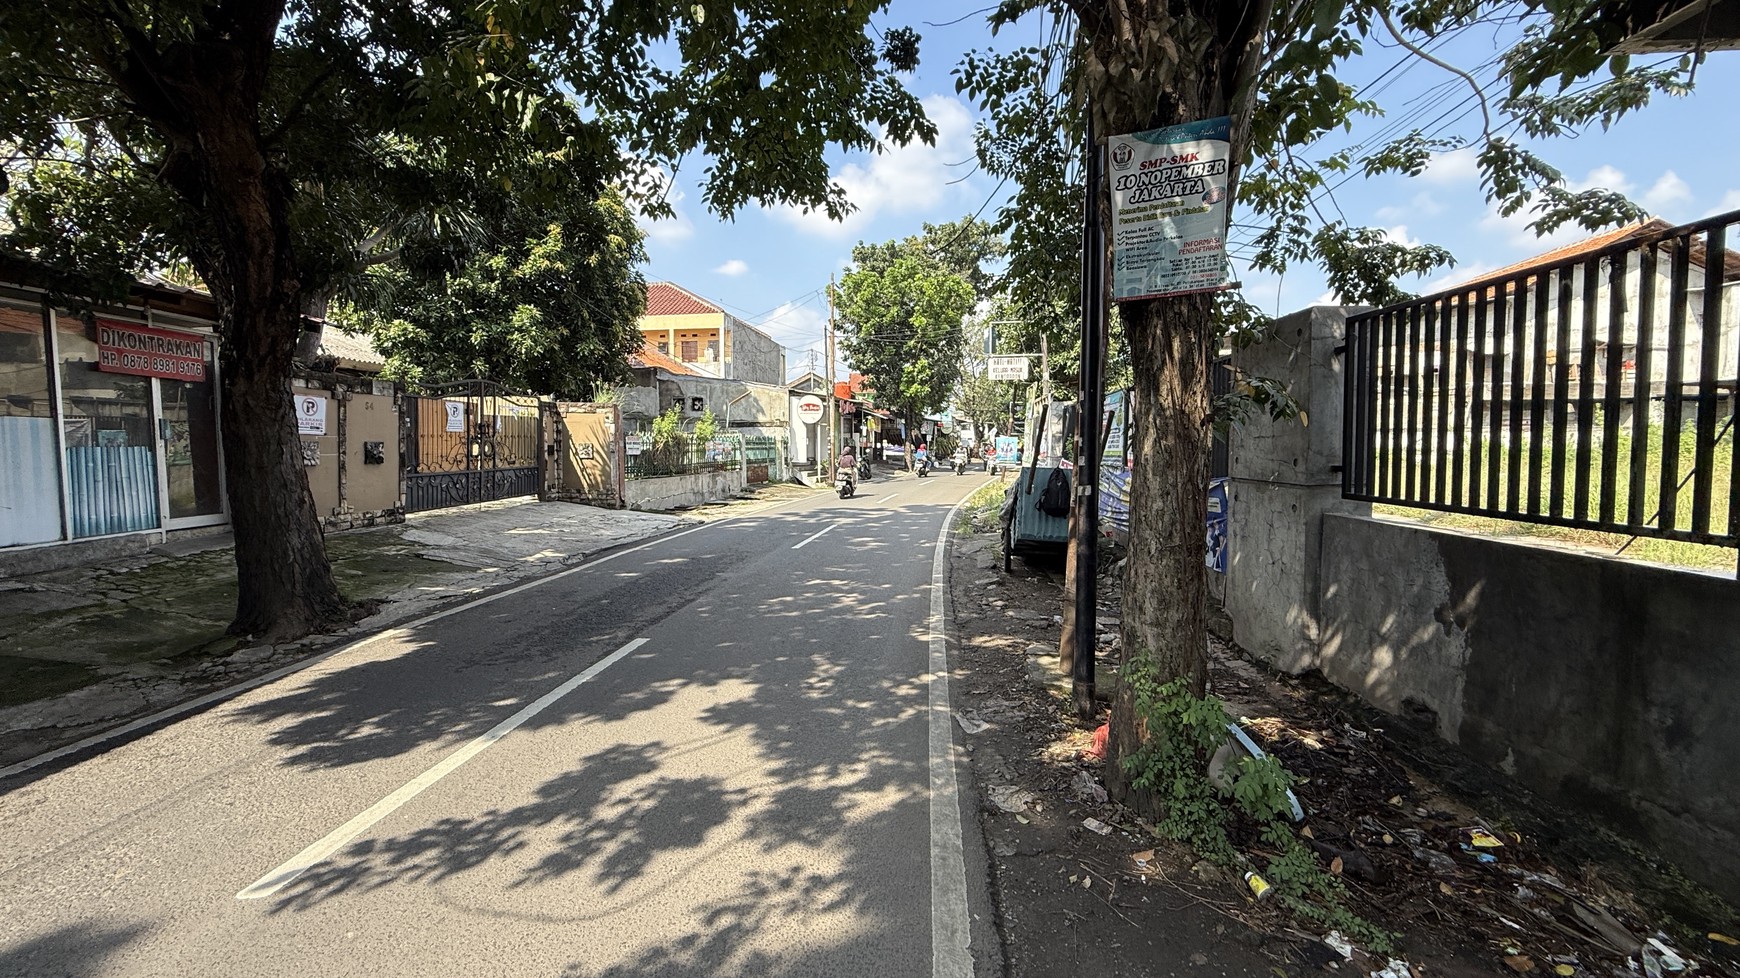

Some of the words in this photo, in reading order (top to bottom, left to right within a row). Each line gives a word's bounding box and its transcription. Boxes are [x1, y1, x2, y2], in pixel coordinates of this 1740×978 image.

[1139, 153, 1200, 170] SMP-SMK
[1116, 174, 1138, 191] 10
[1137, 159, 1226, 187] NOPEMBER
[1129, 178, 1205, 204] JAKARTA
[1178, 244, 1222, 255] PENDAFTARAN
[1184, 237, 1220, 248] INFORMASI
[100, 327, 202, 359] DIKONTRAKAN
[101, 351, 120, 367] HP.
[122, 353, 150, 370] 0878
[152, 357, 176, 373] 8981
[179, 361, 202, 376] 9176
